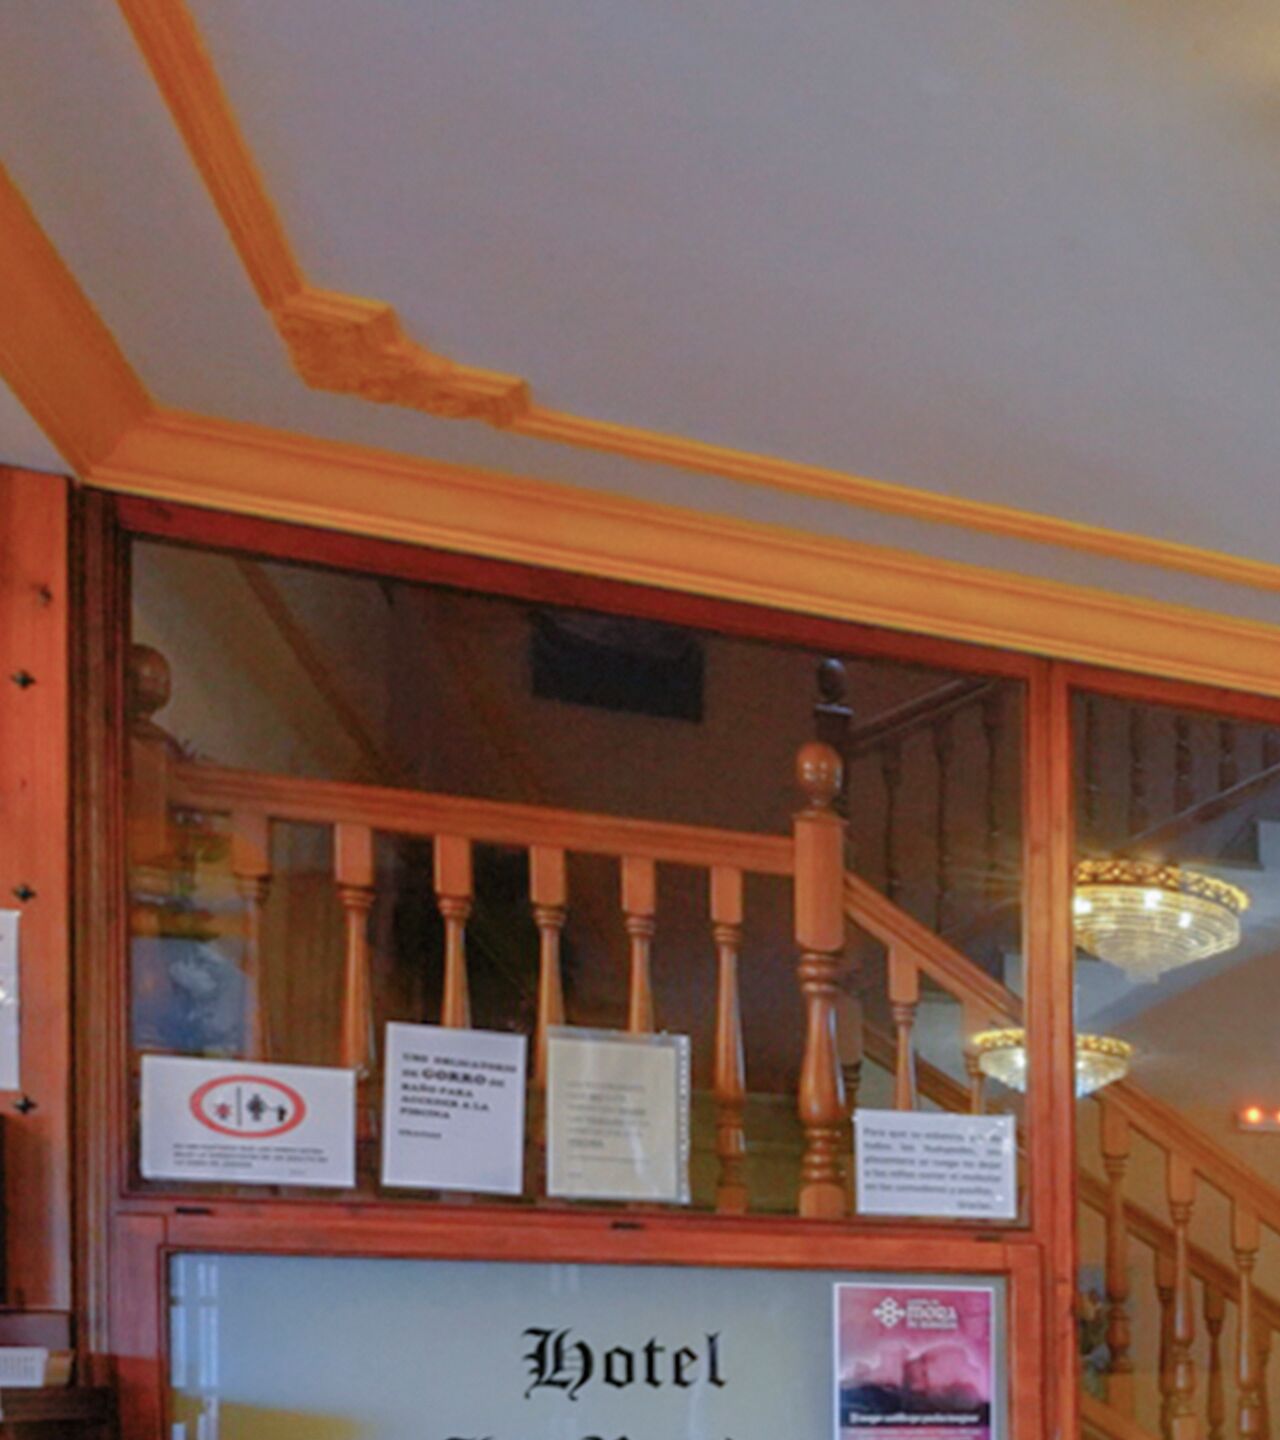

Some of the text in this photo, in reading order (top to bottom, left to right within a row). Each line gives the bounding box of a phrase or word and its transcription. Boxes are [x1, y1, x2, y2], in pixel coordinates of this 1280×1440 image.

[422, 1069, 486, 1086] GORRO
[440, 1086, 473, 1097] PARA
[520, 1326, 727, 1401] Hotel
